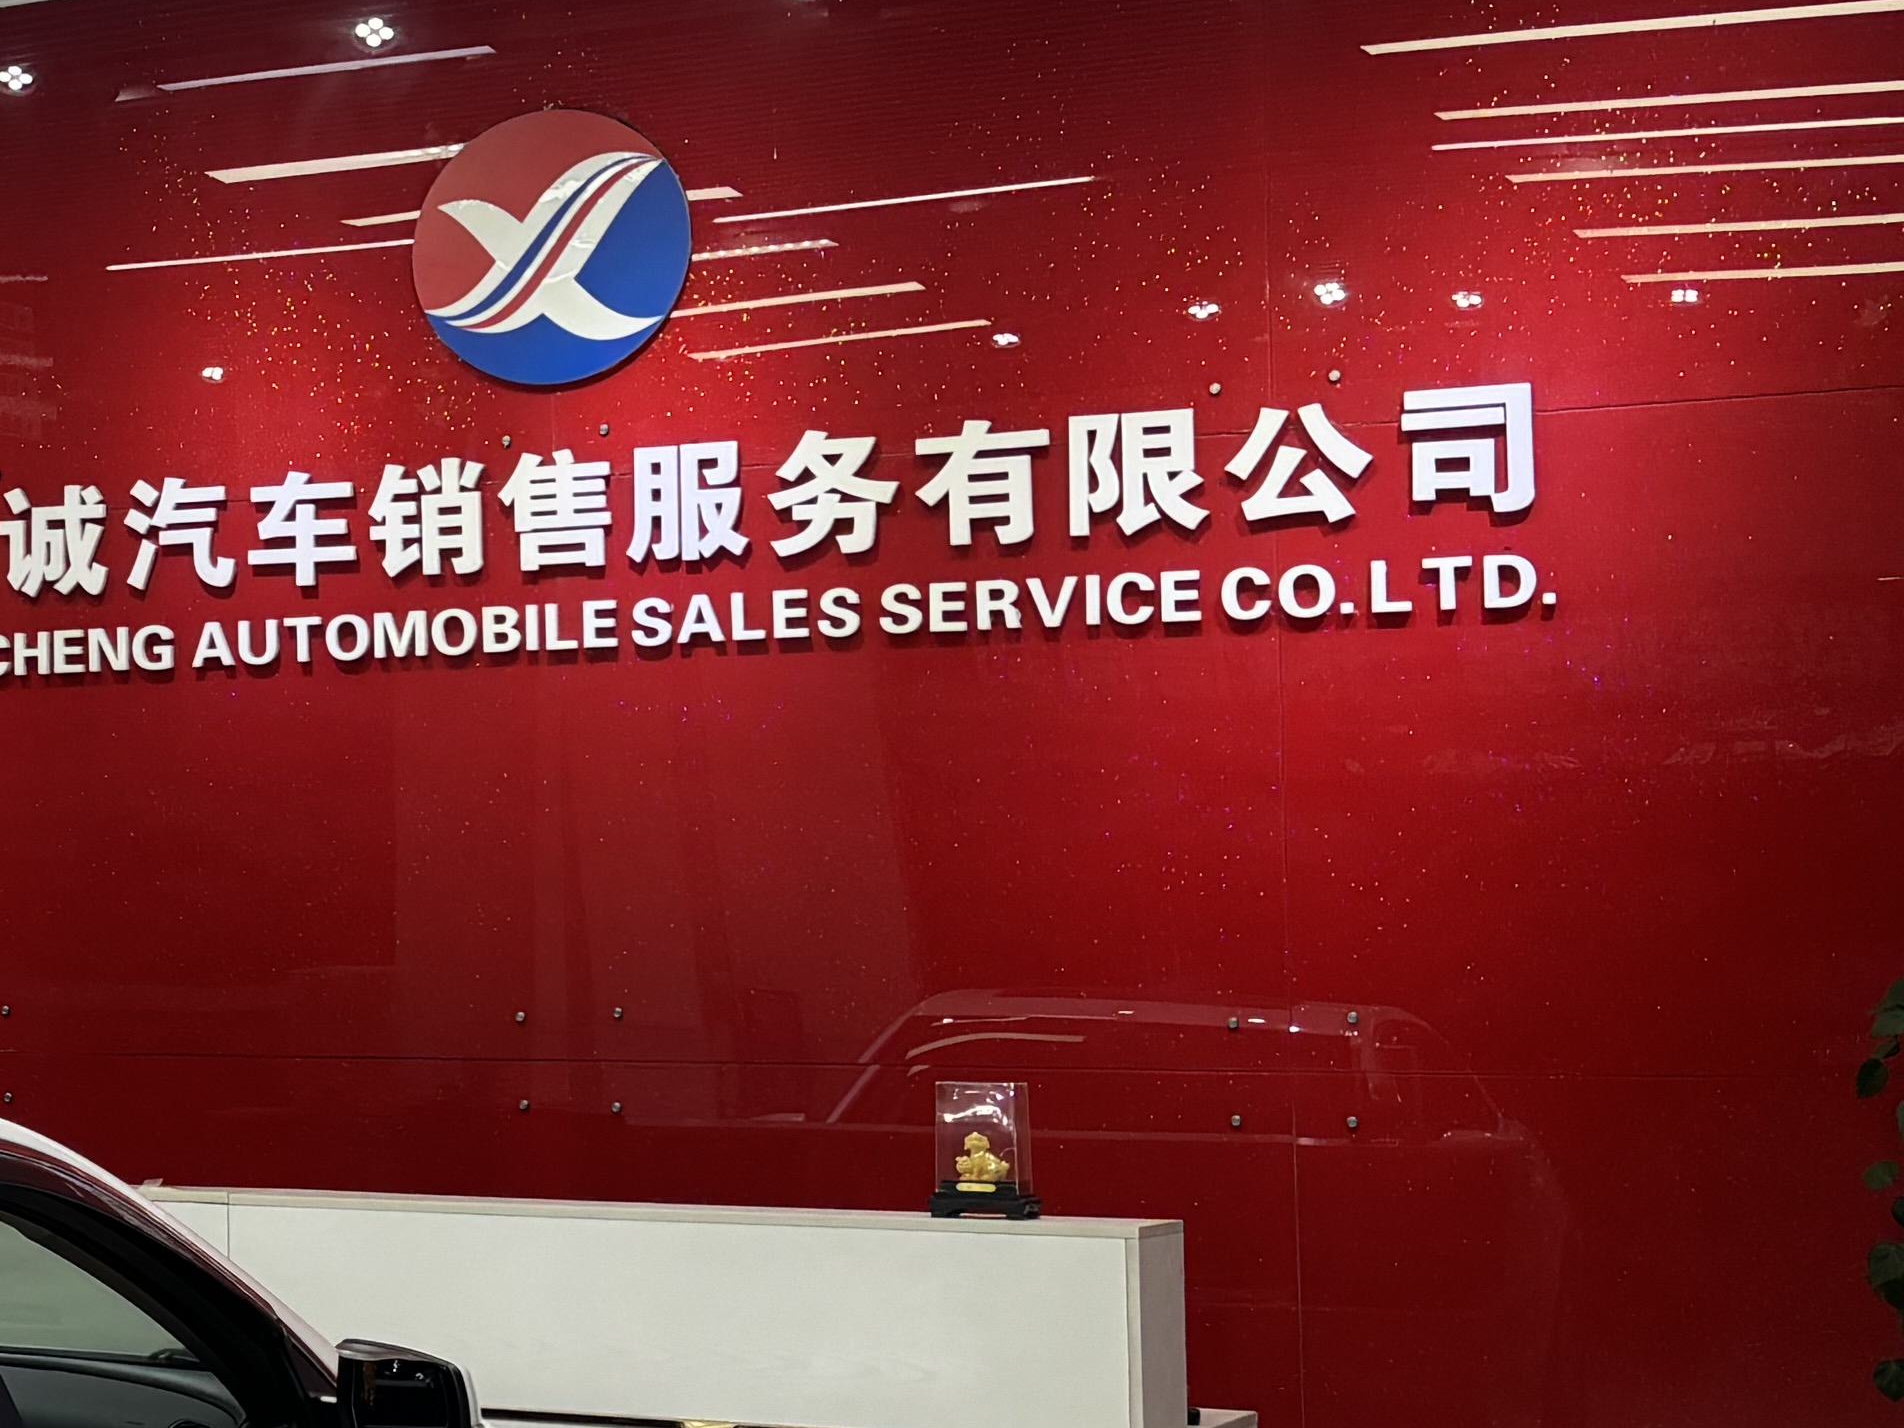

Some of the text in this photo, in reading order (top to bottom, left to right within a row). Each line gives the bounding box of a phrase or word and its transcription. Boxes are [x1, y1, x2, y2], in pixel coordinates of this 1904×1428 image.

[192, 599, 620, 668] AUTOMOBILE
[630, 585, 861, 648] SALES
[879, 570, 1202, 635] SERVICE
